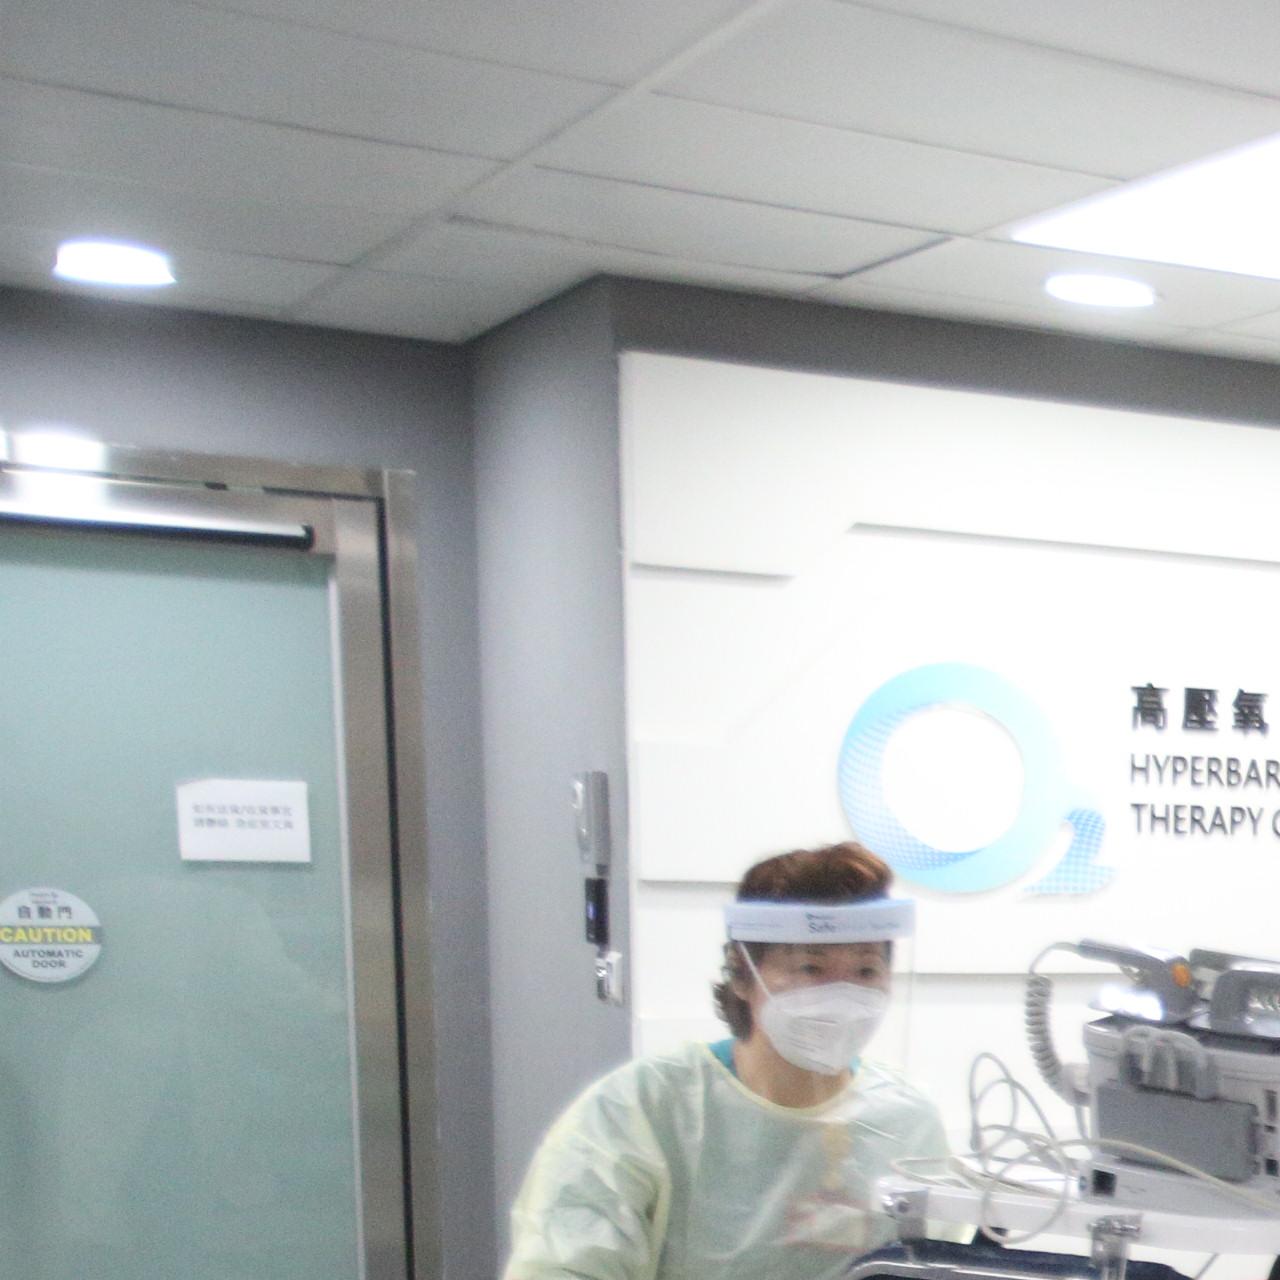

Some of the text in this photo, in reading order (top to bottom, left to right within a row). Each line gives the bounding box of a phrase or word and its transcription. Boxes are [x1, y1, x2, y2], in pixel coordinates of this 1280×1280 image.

[1130, 803, 1264, 837] THERAPY
[0, 927, 93, 943] CAUTION
[14, 950, 84, 958] AUTOMATIC
[32, 960, 66, 968] DOOR
